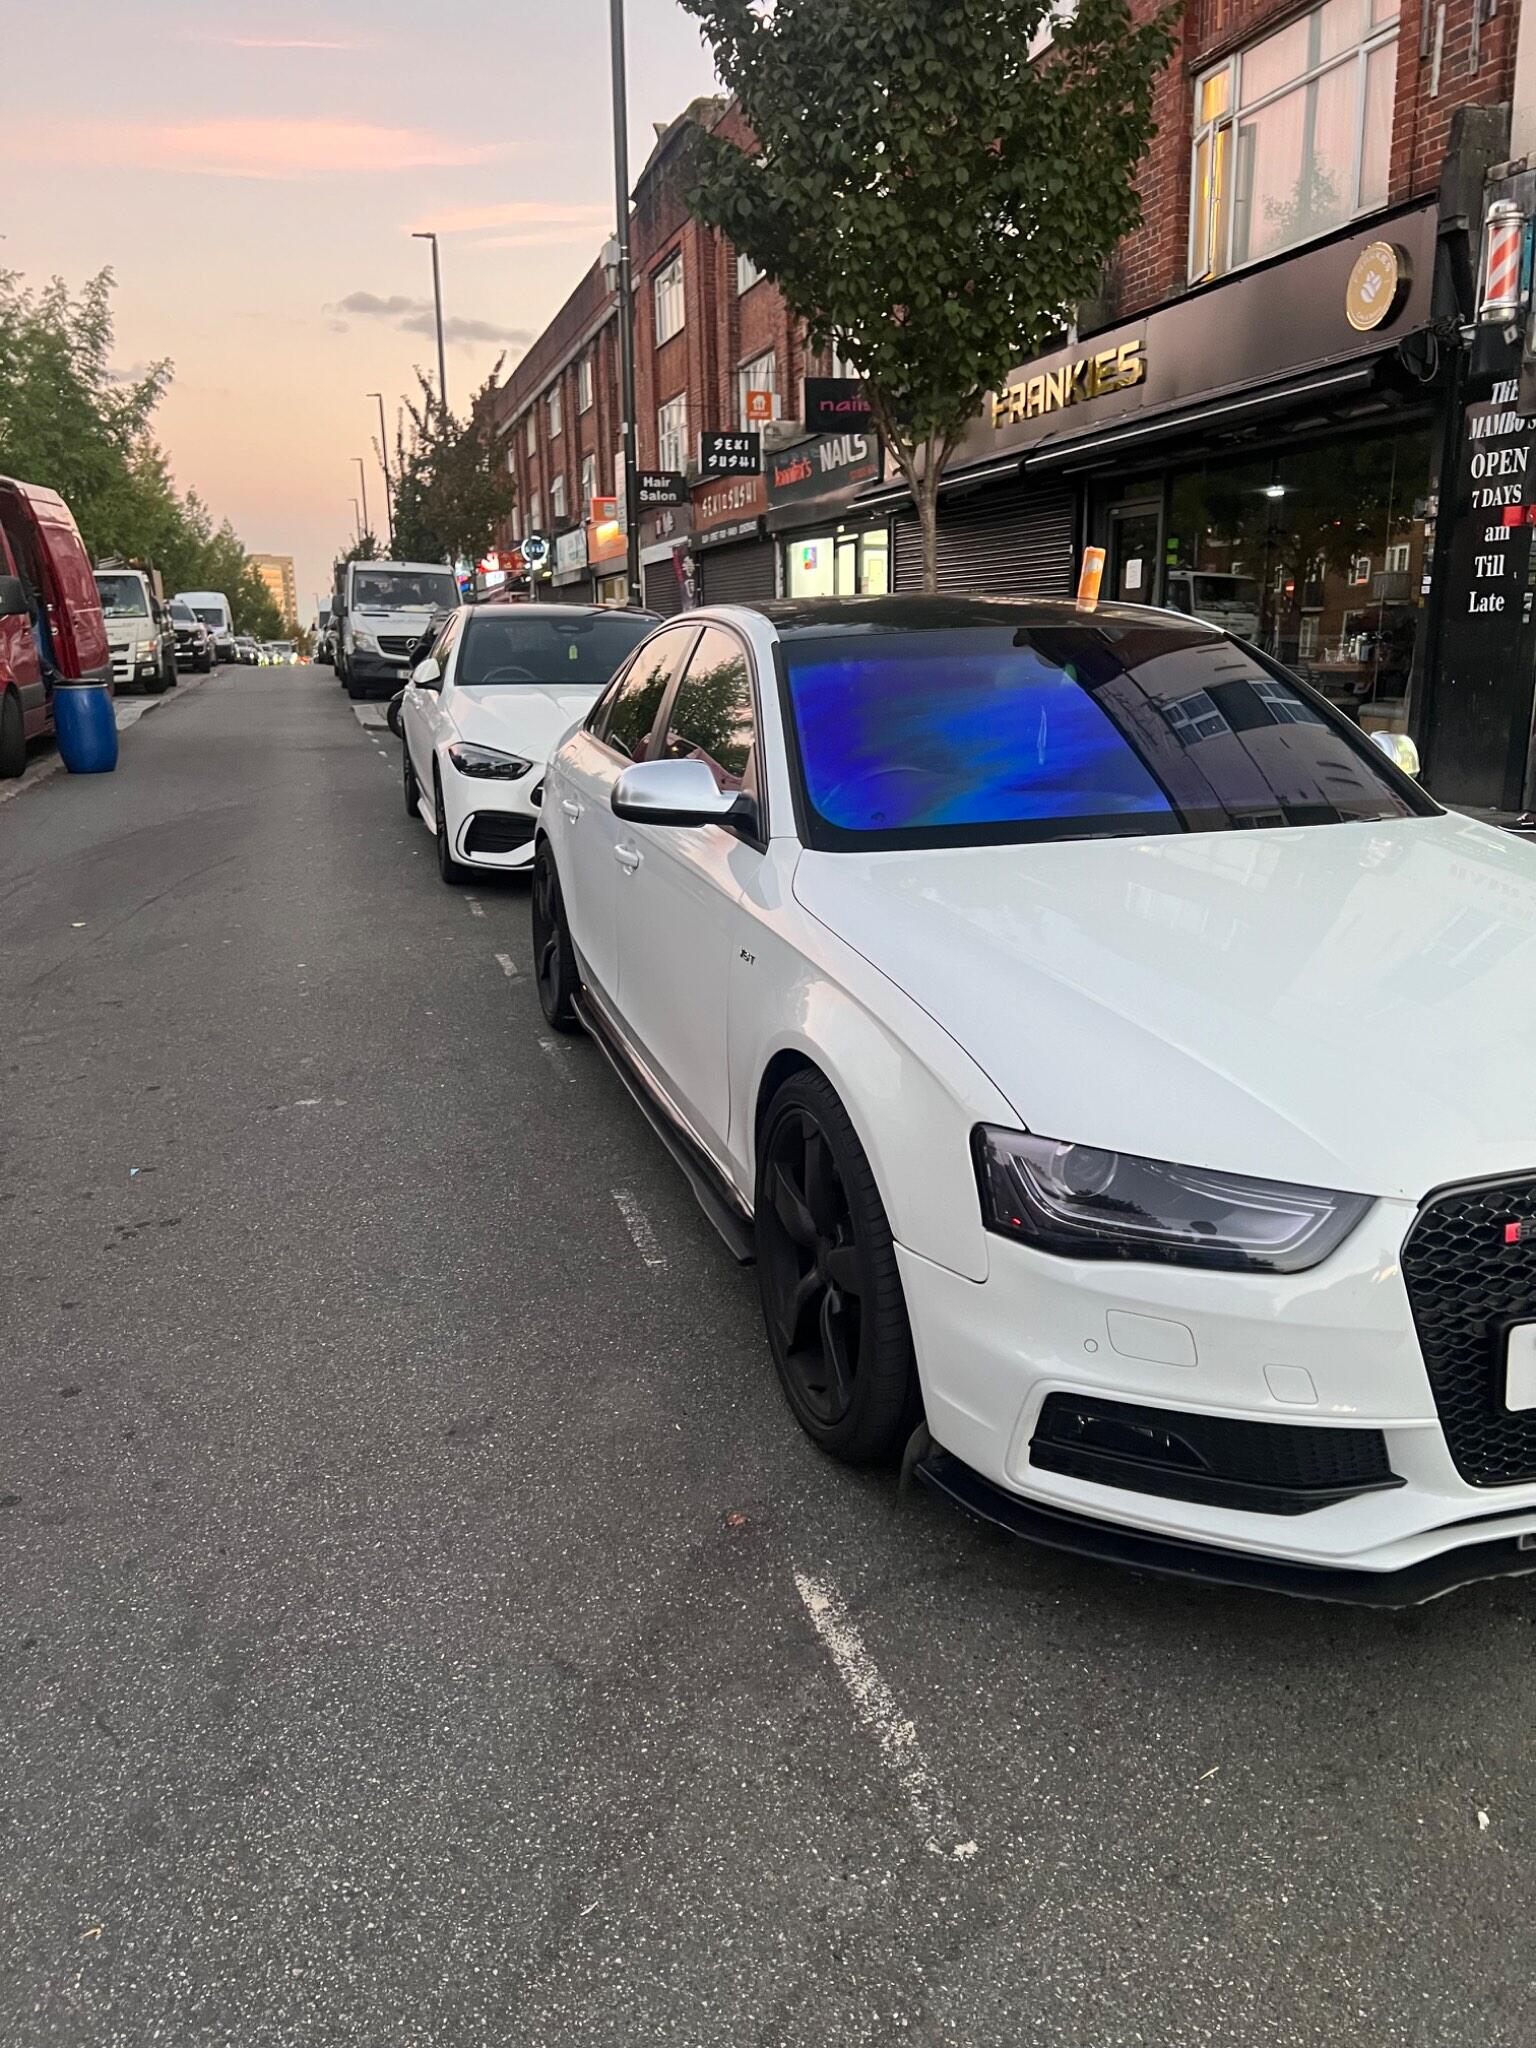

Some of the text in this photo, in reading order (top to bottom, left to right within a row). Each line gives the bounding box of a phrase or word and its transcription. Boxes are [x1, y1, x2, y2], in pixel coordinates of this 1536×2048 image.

[992, 339, 1147, 429] FRANKIES
[1490, 379, 1519, 405] THE
[714, 438, 749, 451] SEKI
[819, 433, 868, 473] NAILS
[708, 455, 756, 469] SUSHI
[1471, 446, 1531, 479] OPEN
[643, 476, 671, 488] Hair
[640, 490, 677, 501] Salon
[1472, 484, 1522, 509] 7 DAYS
[1475, 555, 1505, 578] Till
[1468, 591, 1505, 613] Late
